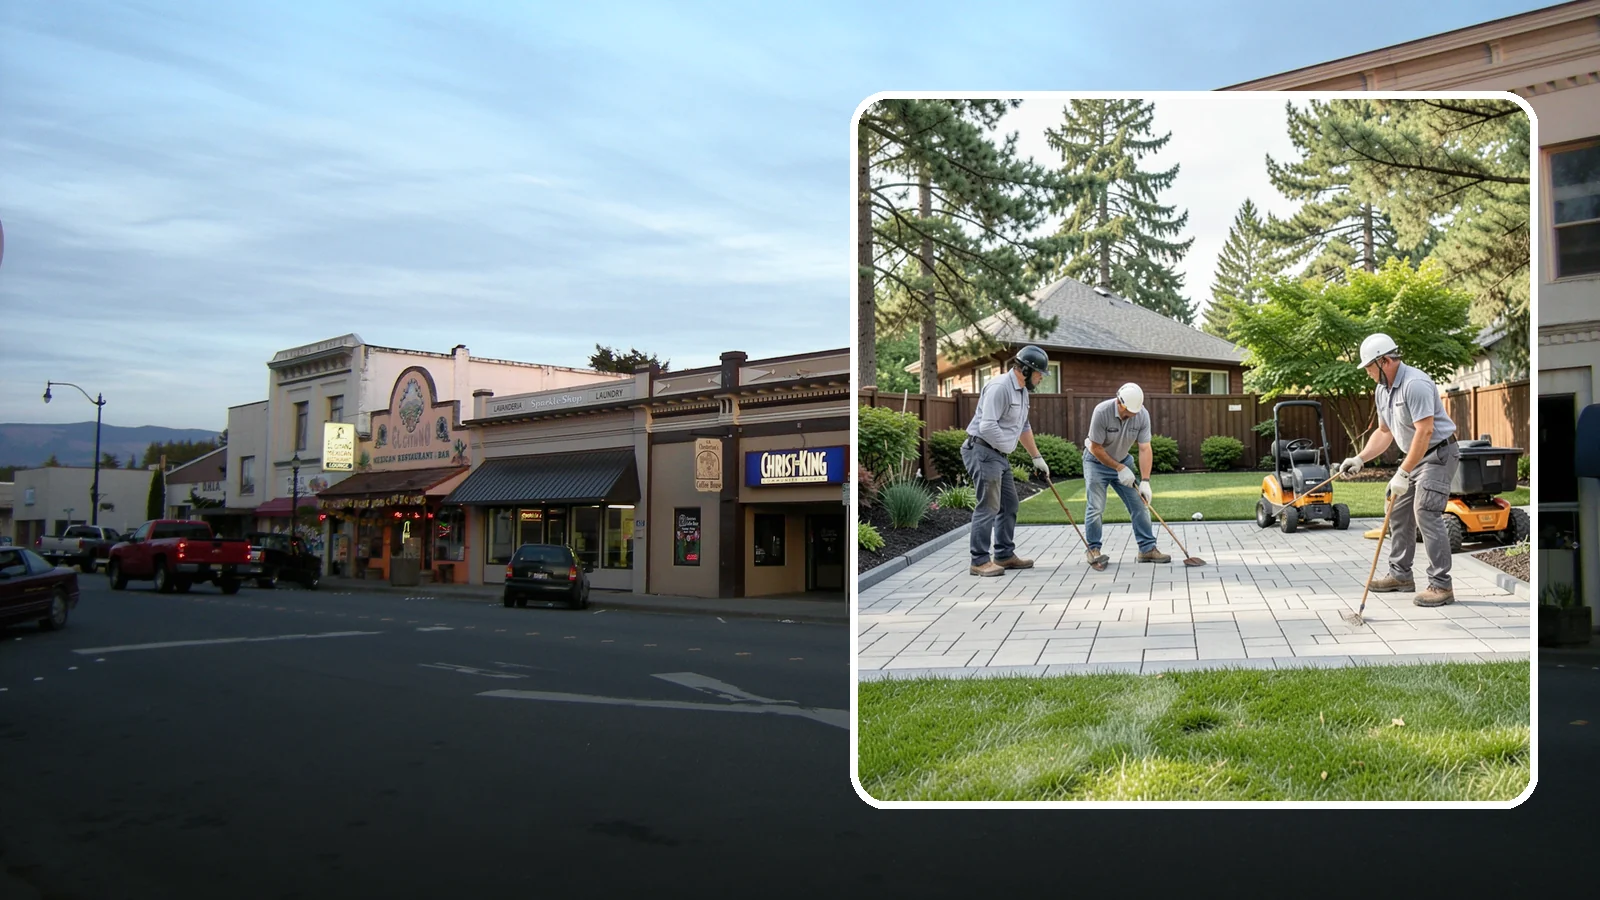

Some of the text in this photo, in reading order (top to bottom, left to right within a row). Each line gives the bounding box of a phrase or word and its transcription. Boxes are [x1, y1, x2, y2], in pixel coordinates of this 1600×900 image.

[595, 388, 624, 400] LAUNDRY
[493, 401, 523, 413] LAVANDERIA
[530, 394, 583, 409] Sparkle Shop
[397, 451, 434, 463] RESTAURANT
[437, 450, 450, 459] BAR
[761, 450, 828, 478] CHRIST KING
